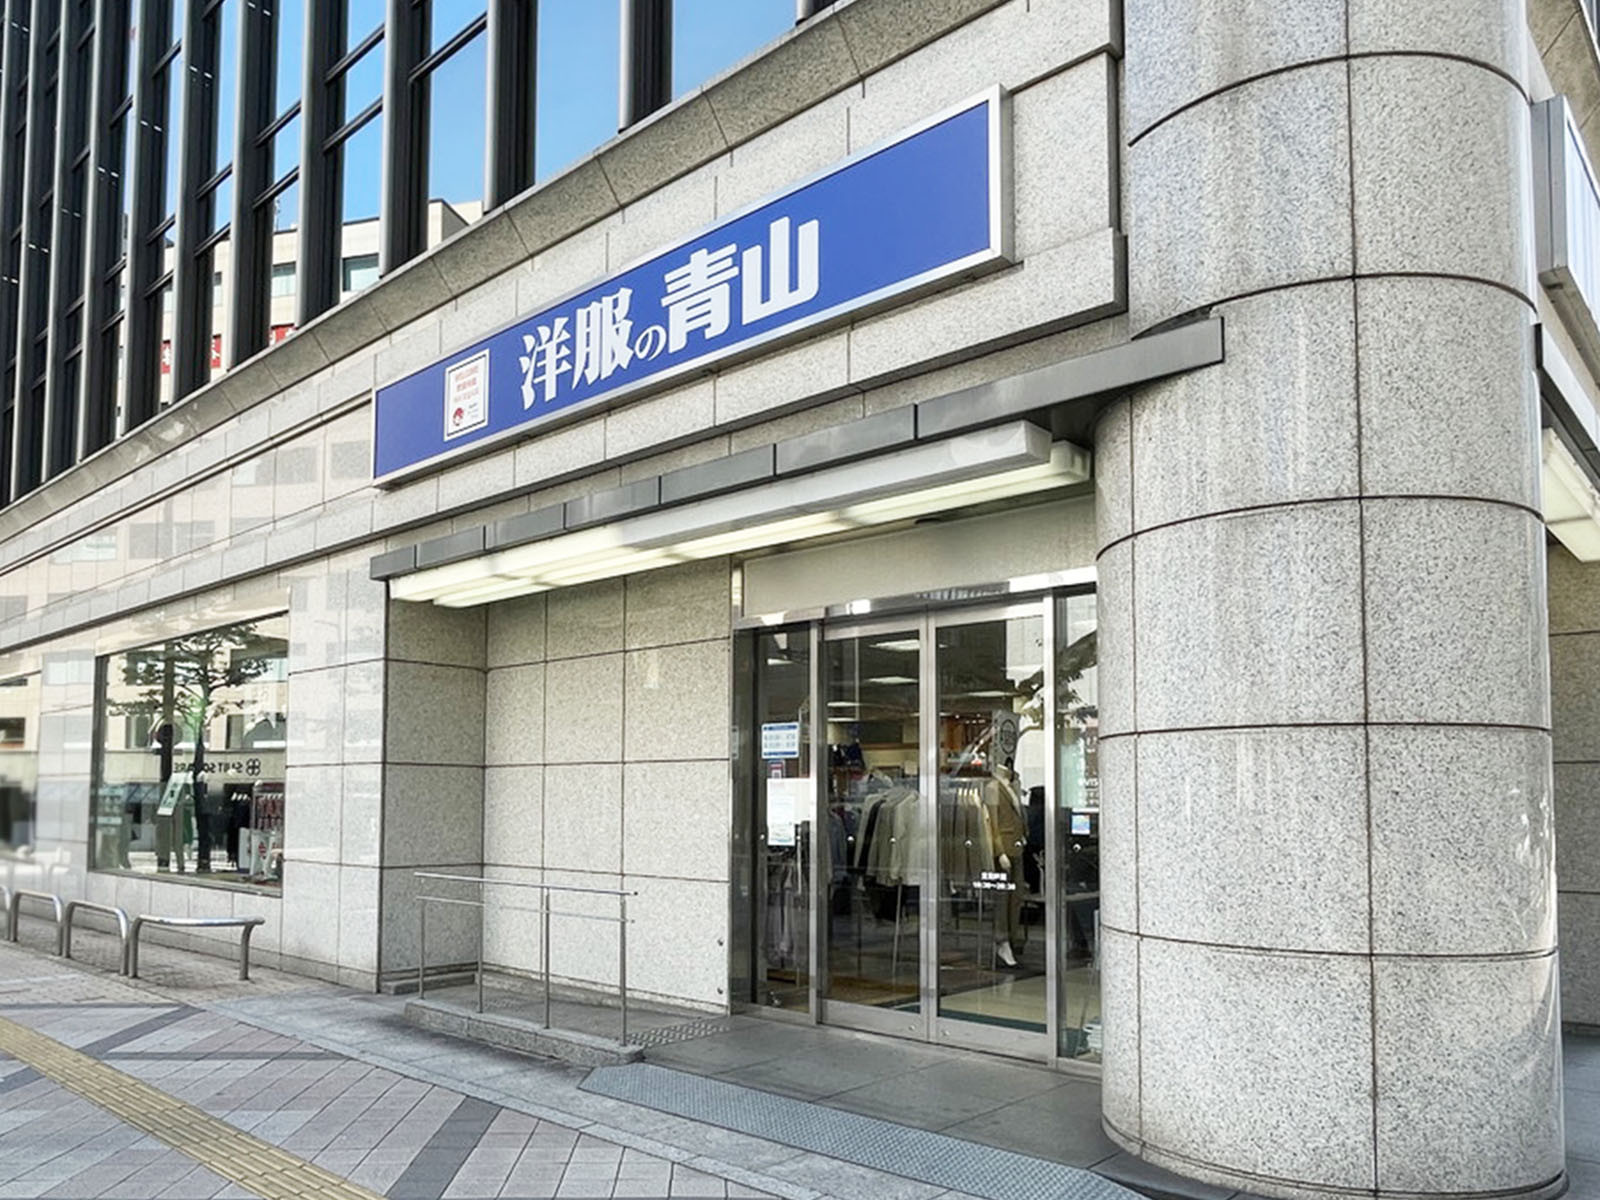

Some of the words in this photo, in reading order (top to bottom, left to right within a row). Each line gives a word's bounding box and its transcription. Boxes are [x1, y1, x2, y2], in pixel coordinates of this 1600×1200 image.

[519, 217, 820, 411] 洋服の青山
